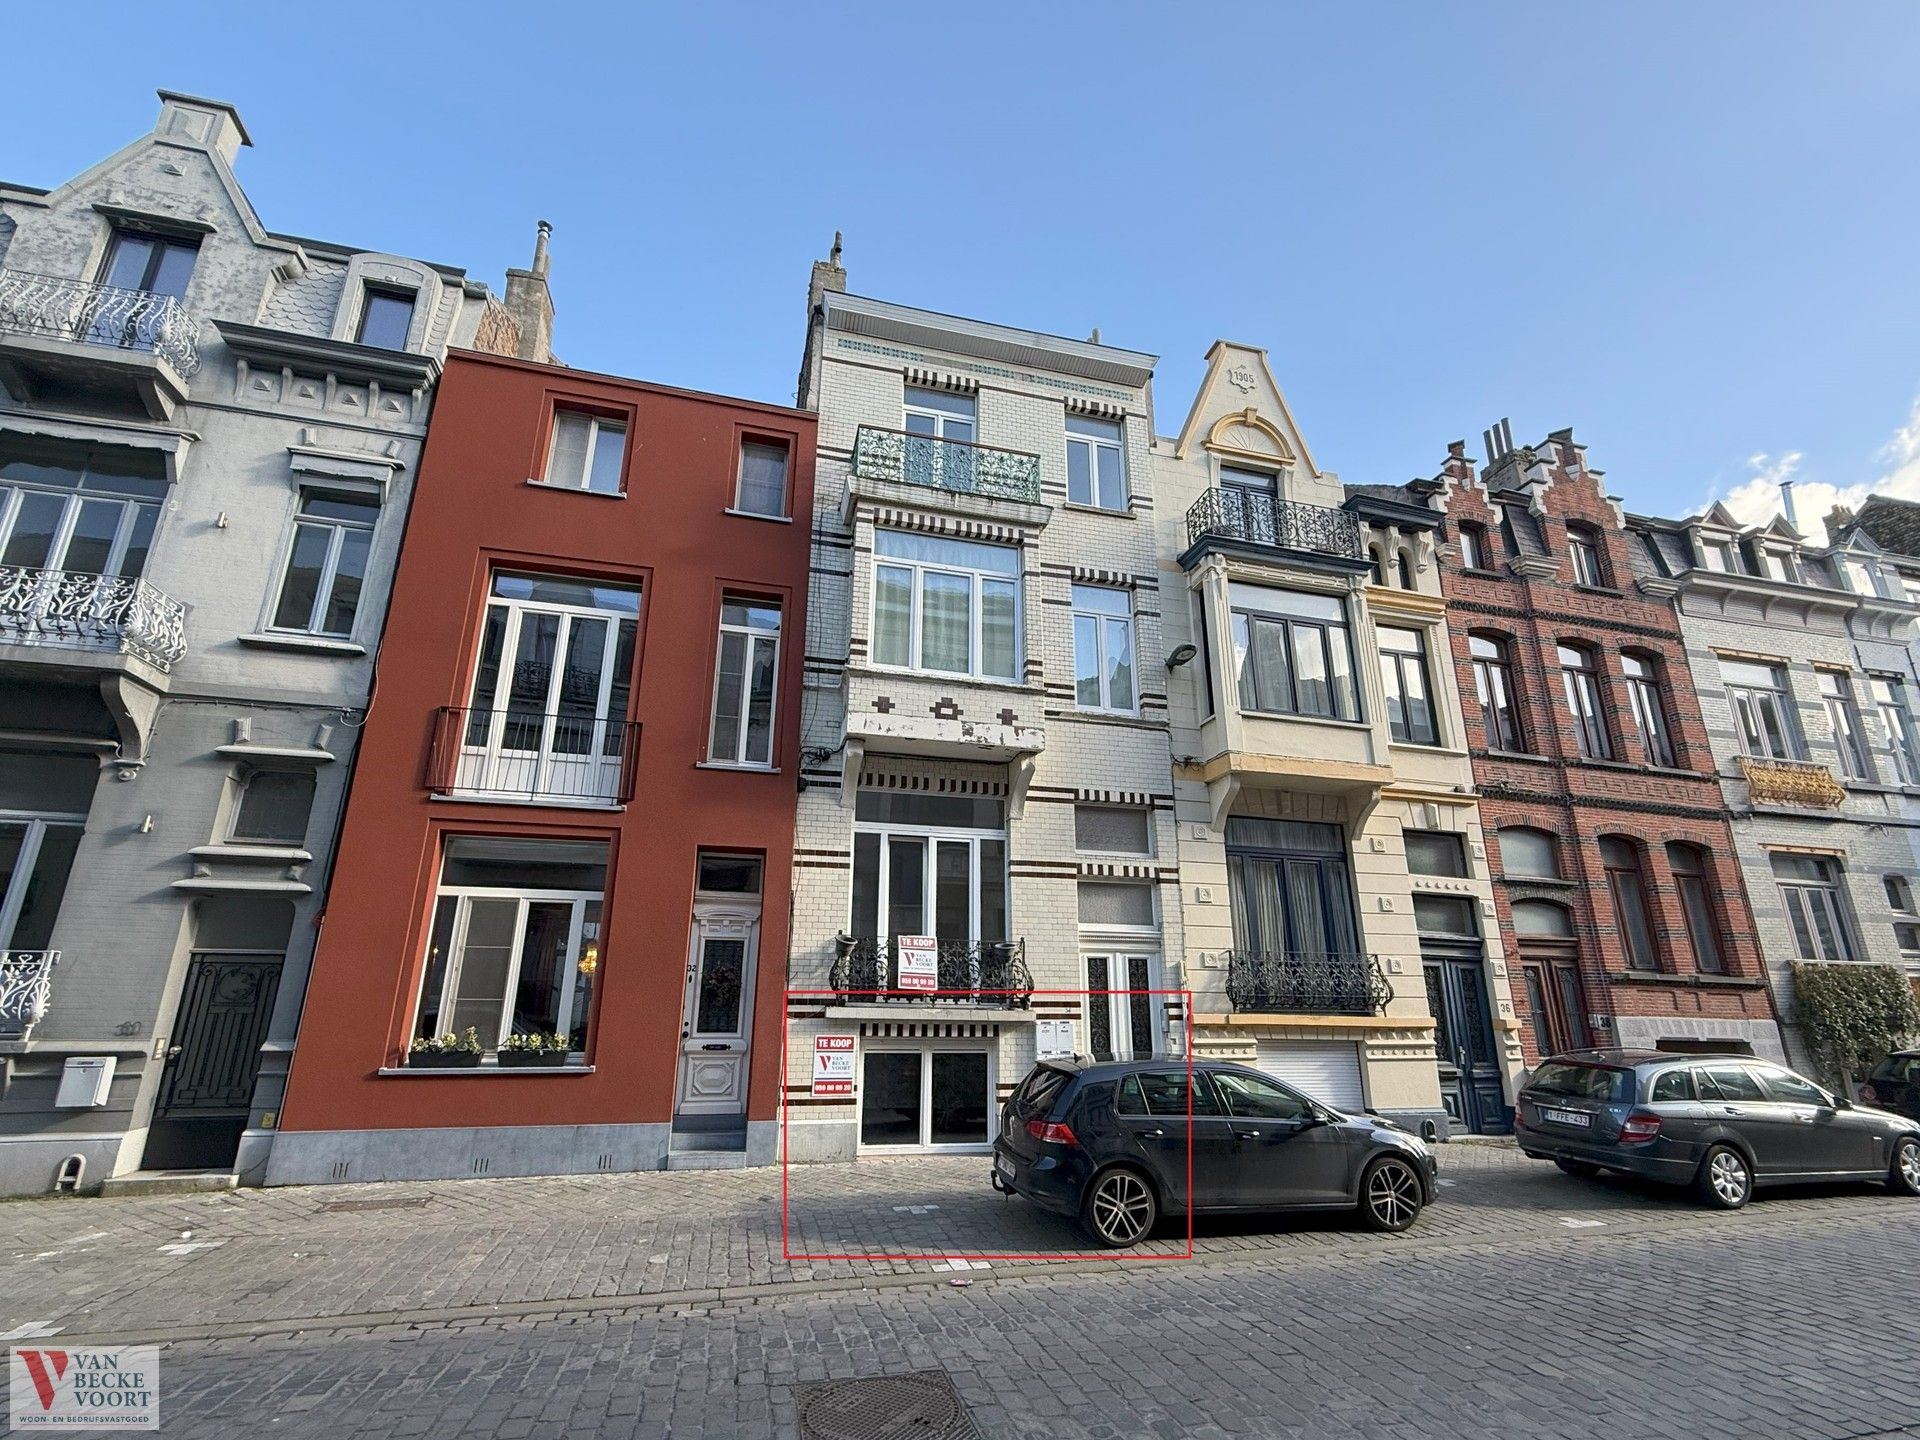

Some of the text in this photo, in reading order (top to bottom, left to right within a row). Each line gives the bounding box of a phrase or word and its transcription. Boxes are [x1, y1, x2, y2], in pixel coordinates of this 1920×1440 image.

[1233, 371, 1255, 384] 1905
[902, 938, 934, 947] TE KOOP
[687, 964, 697, 972] 32
[1500, 1003, 1511, 1013] 36
[1600, 1016, 1611, 1028] 38
[818, 1039, 853, 1048] TE KOOP
[1548, 1111, 1588, 1125] 1-FFE-433
